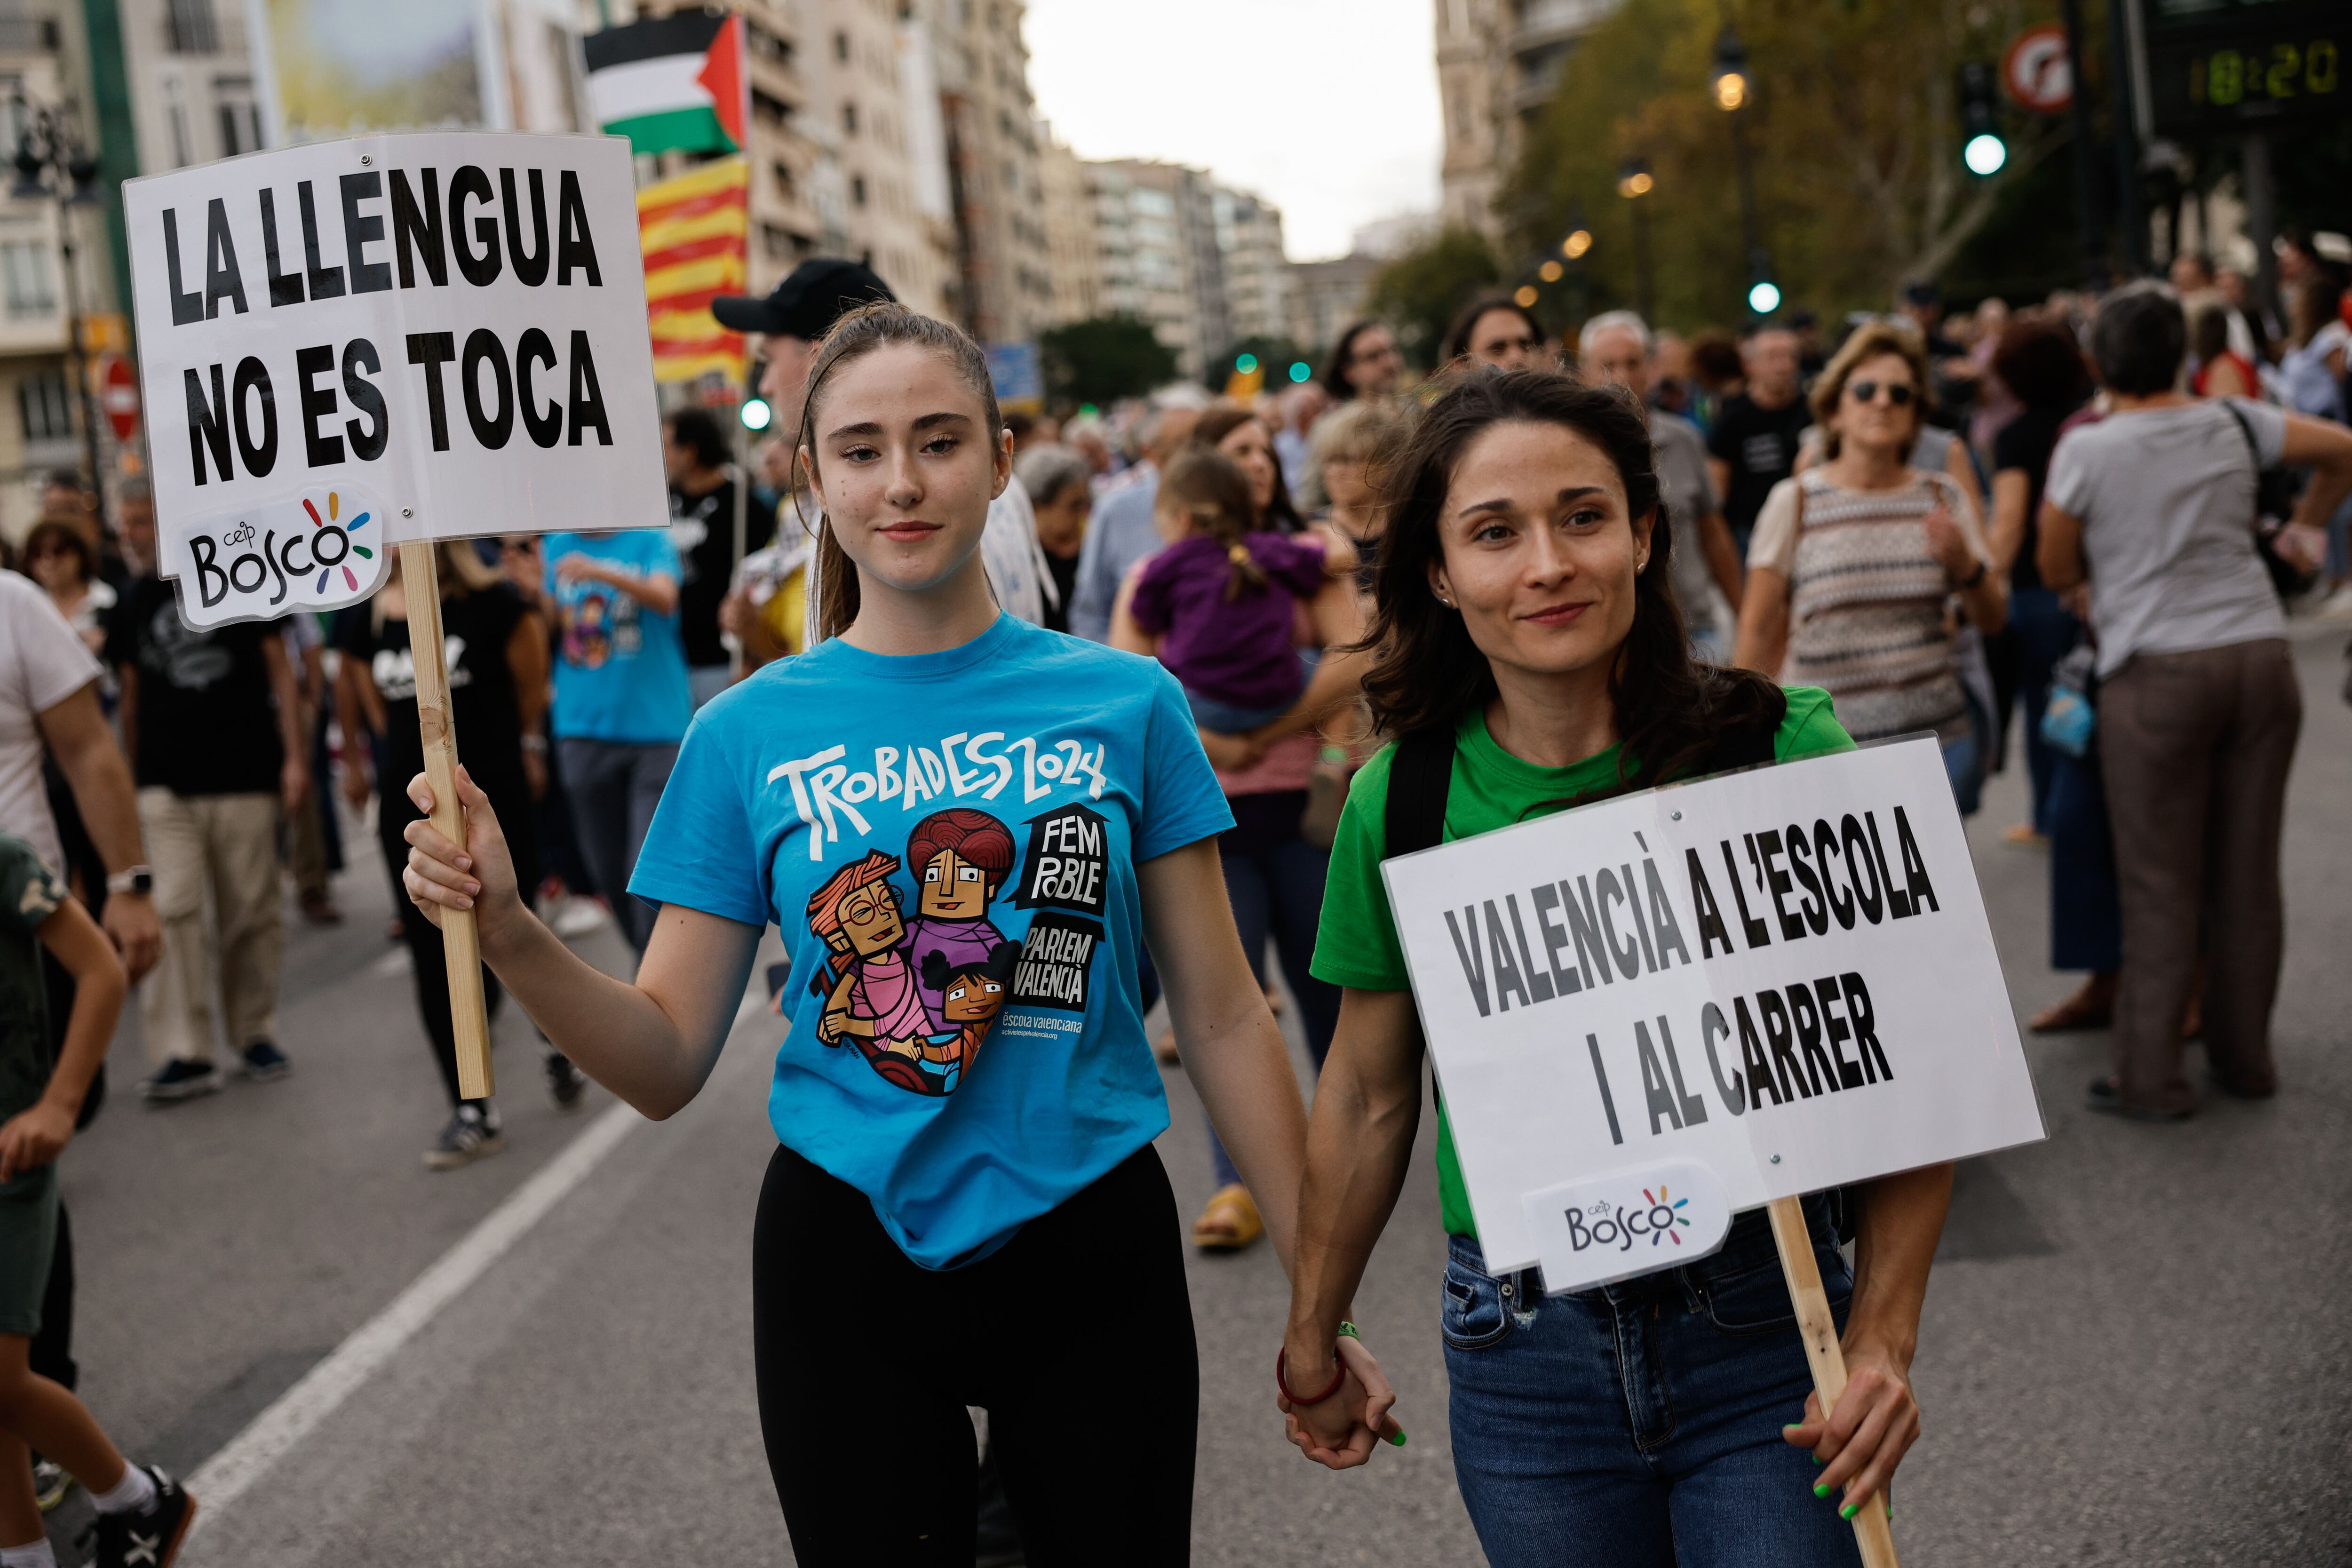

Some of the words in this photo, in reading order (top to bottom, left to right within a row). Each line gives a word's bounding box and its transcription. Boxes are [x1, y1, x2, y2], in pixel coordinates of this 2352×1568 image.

[2189, 40, 2338, 105] 18:20
[162, 198, 249, 326] LA
[259, 165, 603, 308] LLENGUA
[183, 356, 278, 486] NO
[295, 338, 389, 468] ES
[405, 327, 614, 452] TOCA
[223, 521, 255, 549] ceip
[767, 732, 1013, 861] TROBADES
[1004, 737, 1107, 804] 2024
[1042, 815, 1101, 857] FEM
[1443, 830, 1692, 1018] VALENCIÀ
[1685, 847, 1735, 960] A
[1719, 805, 1940, 949] L'ESCOLA
[1021, 927, 1093, 964] PARLEM
[1014, 961, 1082, 1004] VALENCIÀ
[1033, 1017, 1082, 1034] valenciana
[1586, 1033, 1624, 1146] I
[1634, 1015, 1708, 1136] AL
[1701, 971, 1894, 1116] CARRER
[1588, 1200, 1611, 1217] ceip
